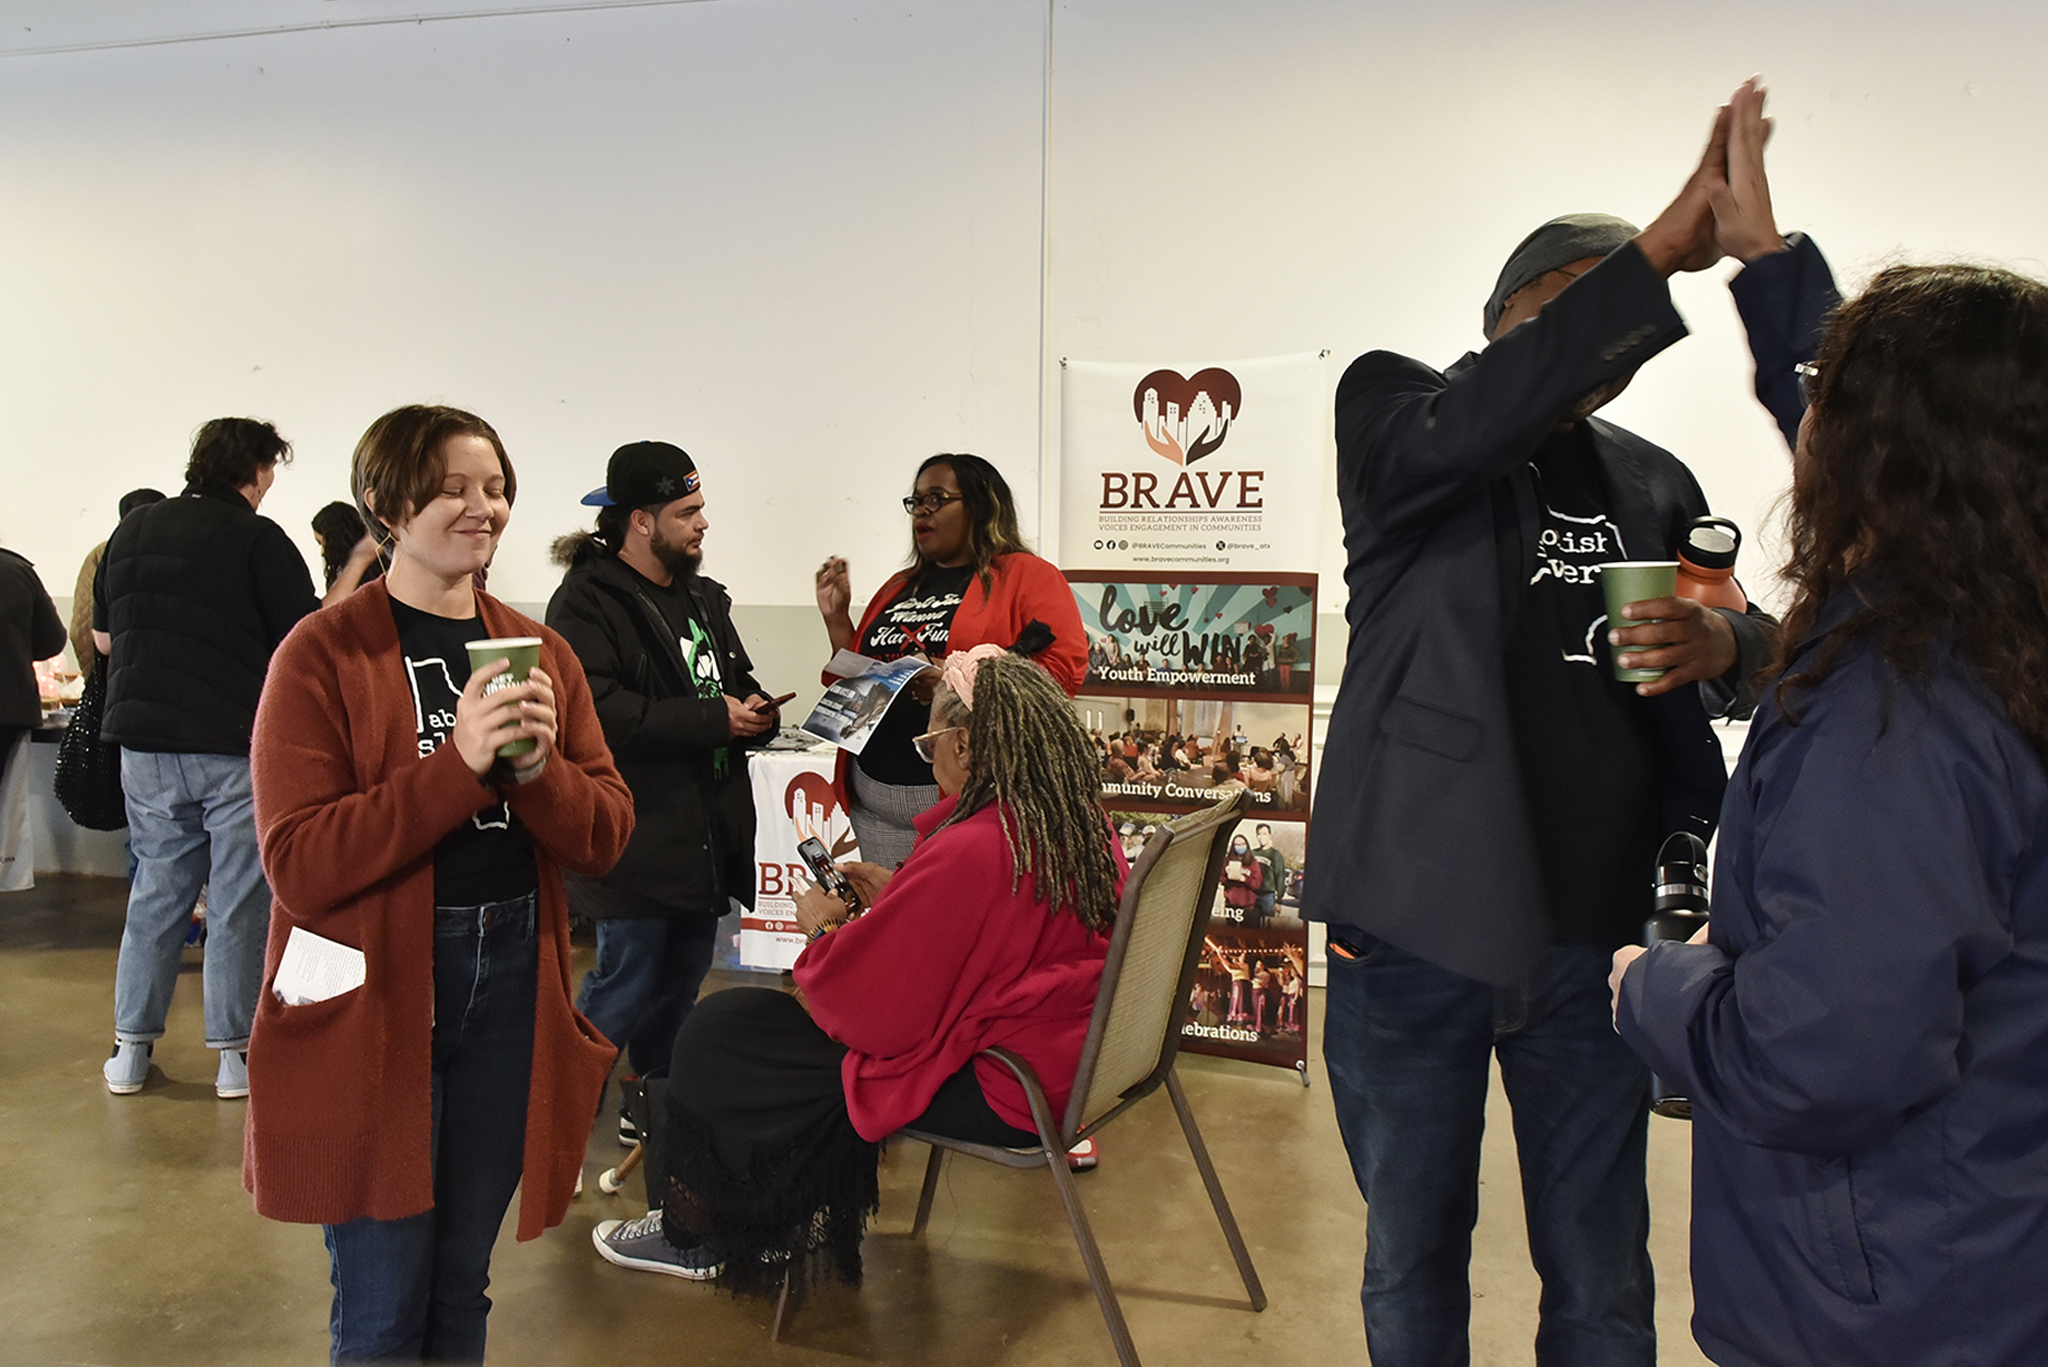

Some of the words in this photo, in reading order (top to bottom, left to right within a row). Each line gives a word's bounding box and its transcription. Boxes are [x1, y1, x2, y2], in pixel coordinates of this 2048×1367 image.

[1099, 470, 1264, 509] BRAVE
[1098, 515, 1140, 523] BUILDING
[1142, 515, 1208, 523] RELATIONSHIPS
[1210, 515, 1262, 523] AWARENESS
[1098, 524, 1128, 532] VOICES
[1130, 524, 1188, 532] ENGAGEMENT
[1189, 524, 1199, 532] IN
[1200, 524, 1262, 532] COMMUNITIES
[1131, 541, 1207, 550] @BRAVECommunities
[1132, 555, 1230, 565] www.bravecommunities.org
[1099, 584, 1189, 637] love
[1134, 632, 1181, 657] will
[1098, 666, 1144, 682] Youth
[1146, 668, 1256, 686] Empowerment
